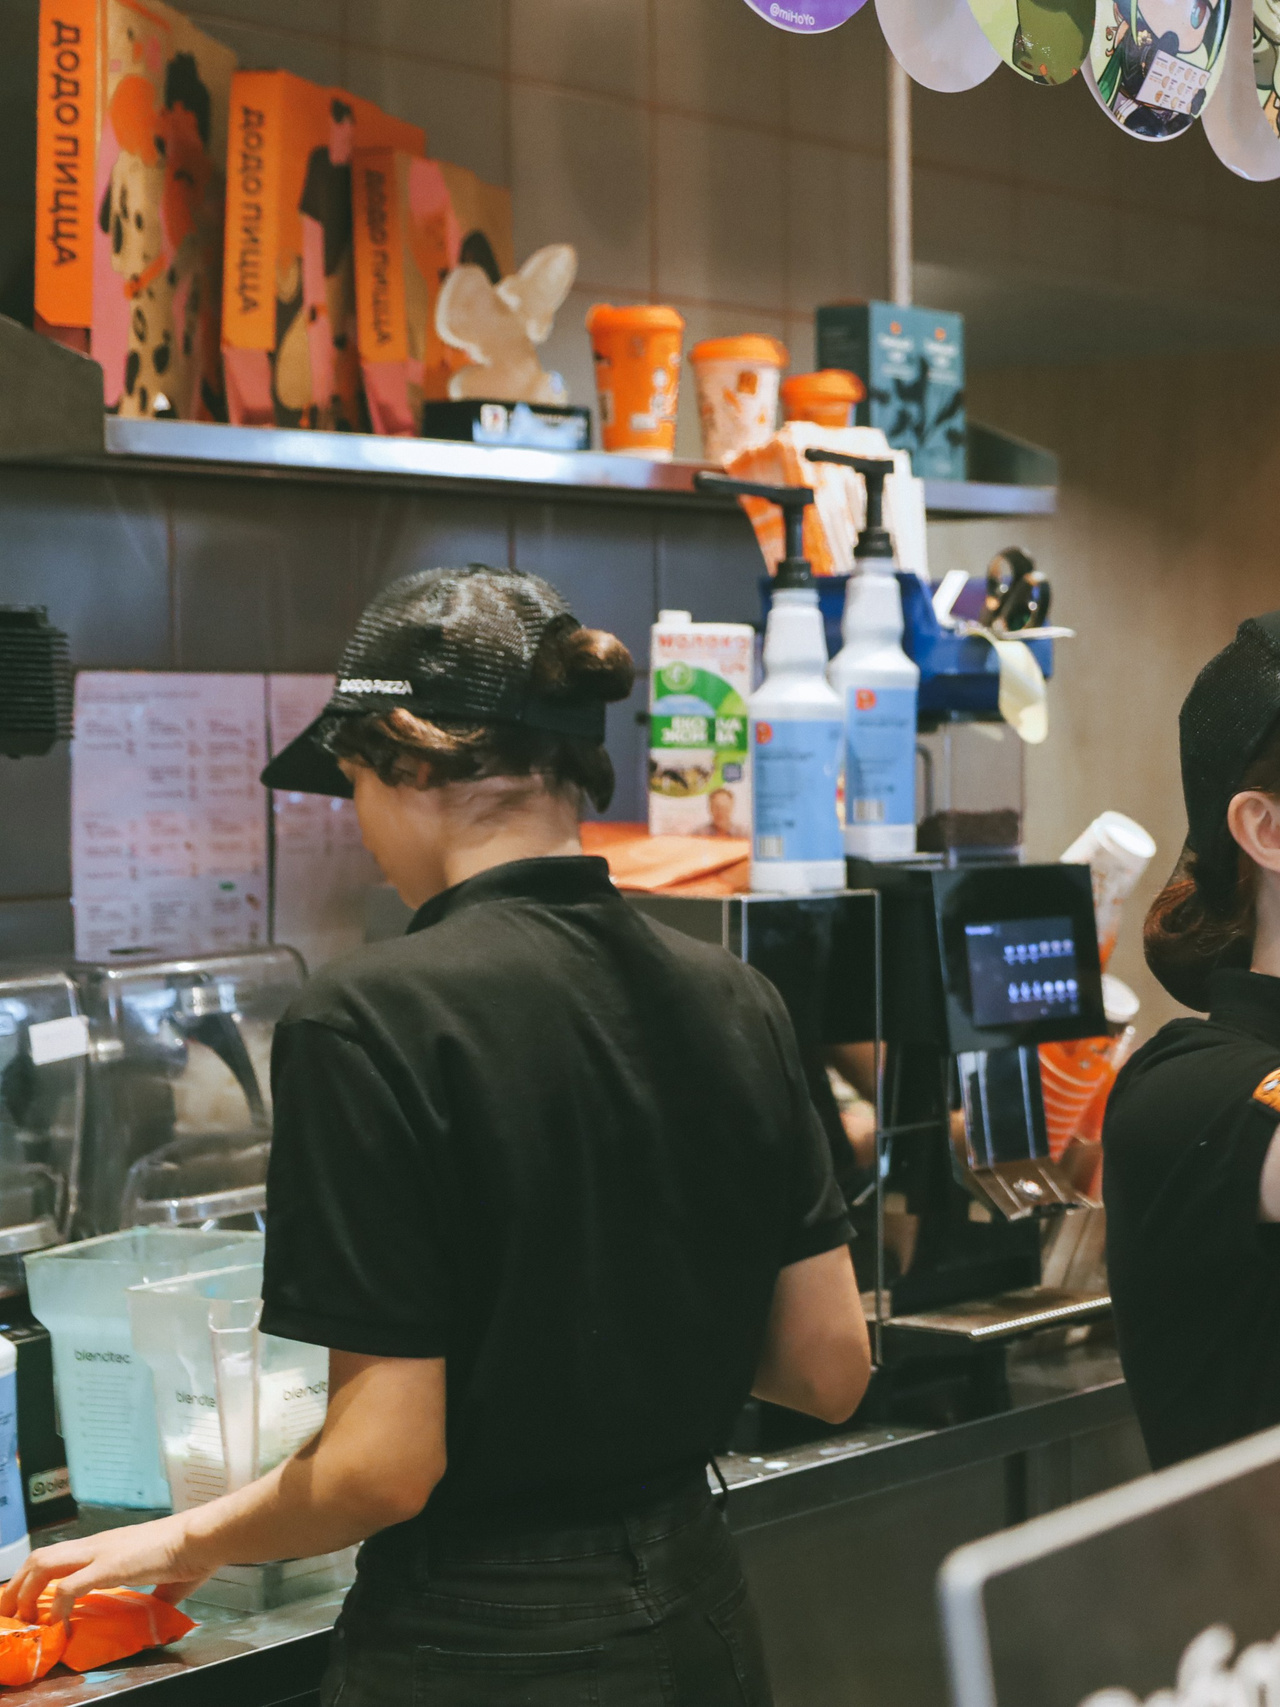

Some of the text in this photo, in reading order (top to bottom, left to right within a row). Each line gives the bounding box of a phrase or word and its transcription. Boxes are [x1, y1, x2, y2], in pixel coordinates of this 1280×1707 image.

[769, 3, 816, 26] @miHoYo
[49, 20, 81, 266] ДОДО ПИЦЦА
[238, 105, 265, 315] ДОДО ПИЦЦА
[74, 1349, 132, 1364] blendtec
[175, 1389, 217, 1407] blendte
